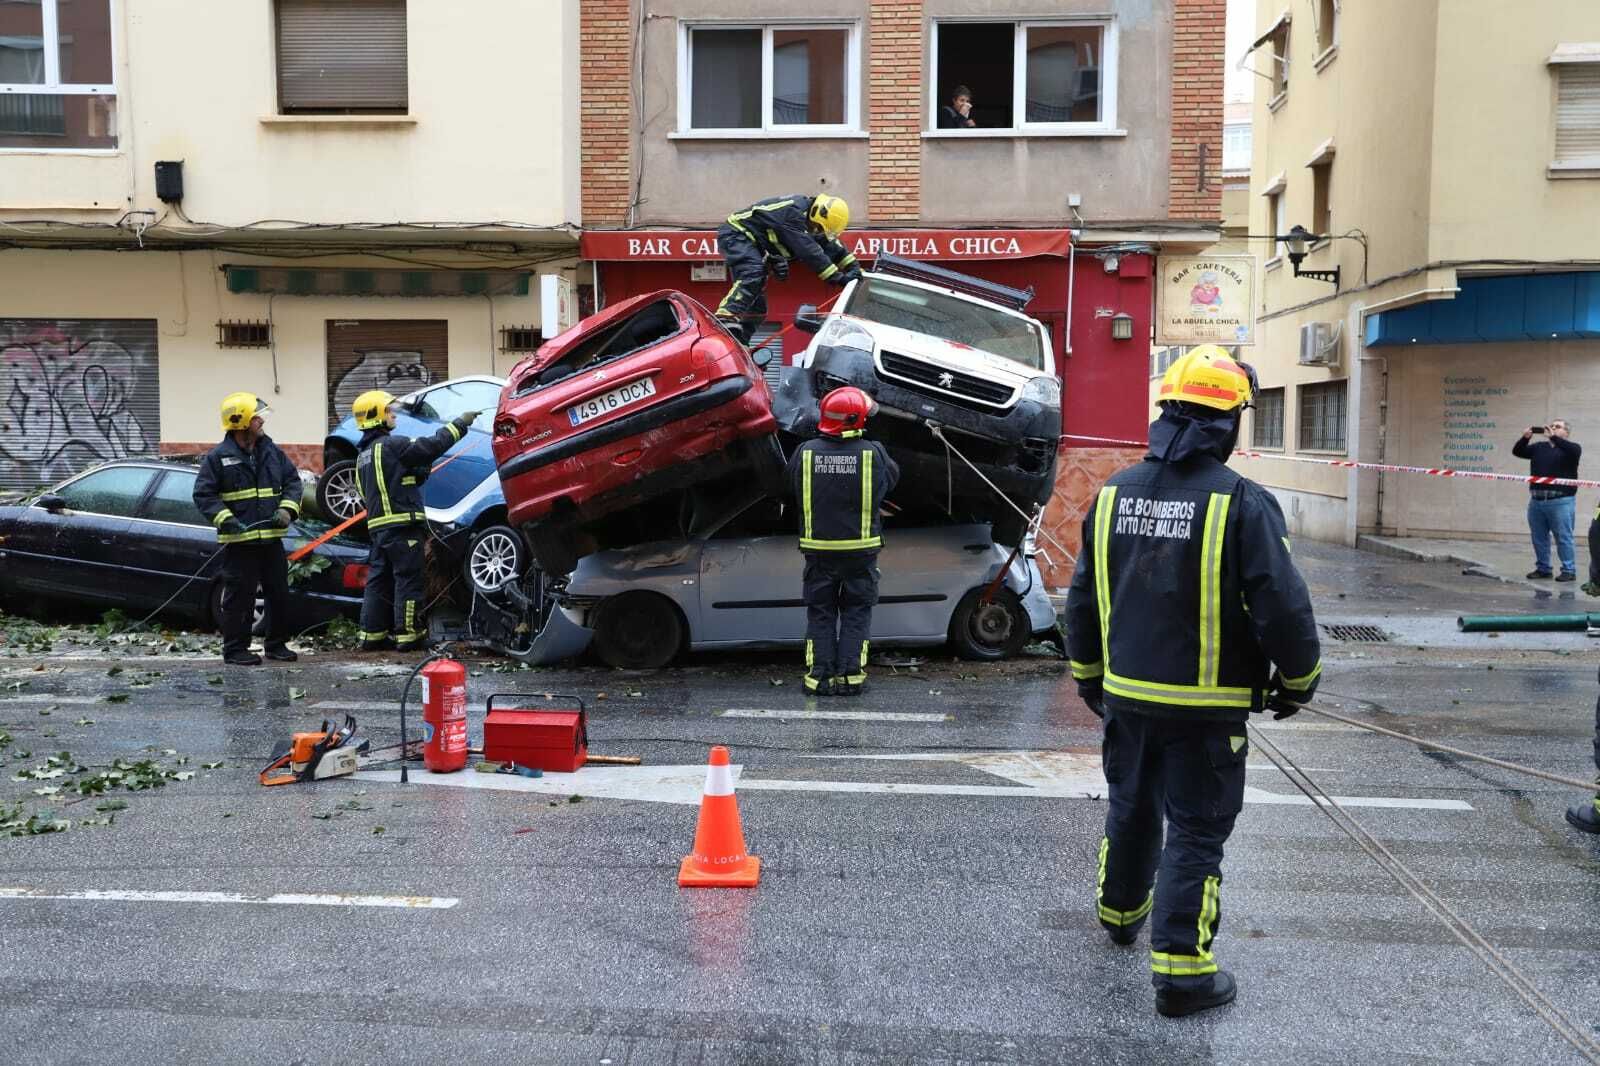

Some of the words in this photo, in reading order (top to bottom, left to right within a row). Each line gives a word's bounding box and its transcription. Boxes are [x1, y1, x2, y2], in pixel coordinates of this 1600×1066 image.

[628, 238, 672, 256] BAR
[853, 237, 939, 256] ABUELA
[949, 237, 1022, 255] CHICA
[1172, 268, 1189, 284] BAR
[581, 394, 618, 419] 4916
[620, 380, 651, 403] DCX
[824, 455, 856, 464] BOMBEROS
[1118, 497, 1134, 515] RC
[1135, 498, 1196, 520] BOMBEROS
[1115, 516, 1139, 535] AYTO
[1139, 517, 1155, 537] DE
[1154, 519, 1191, 540] MALAGA
